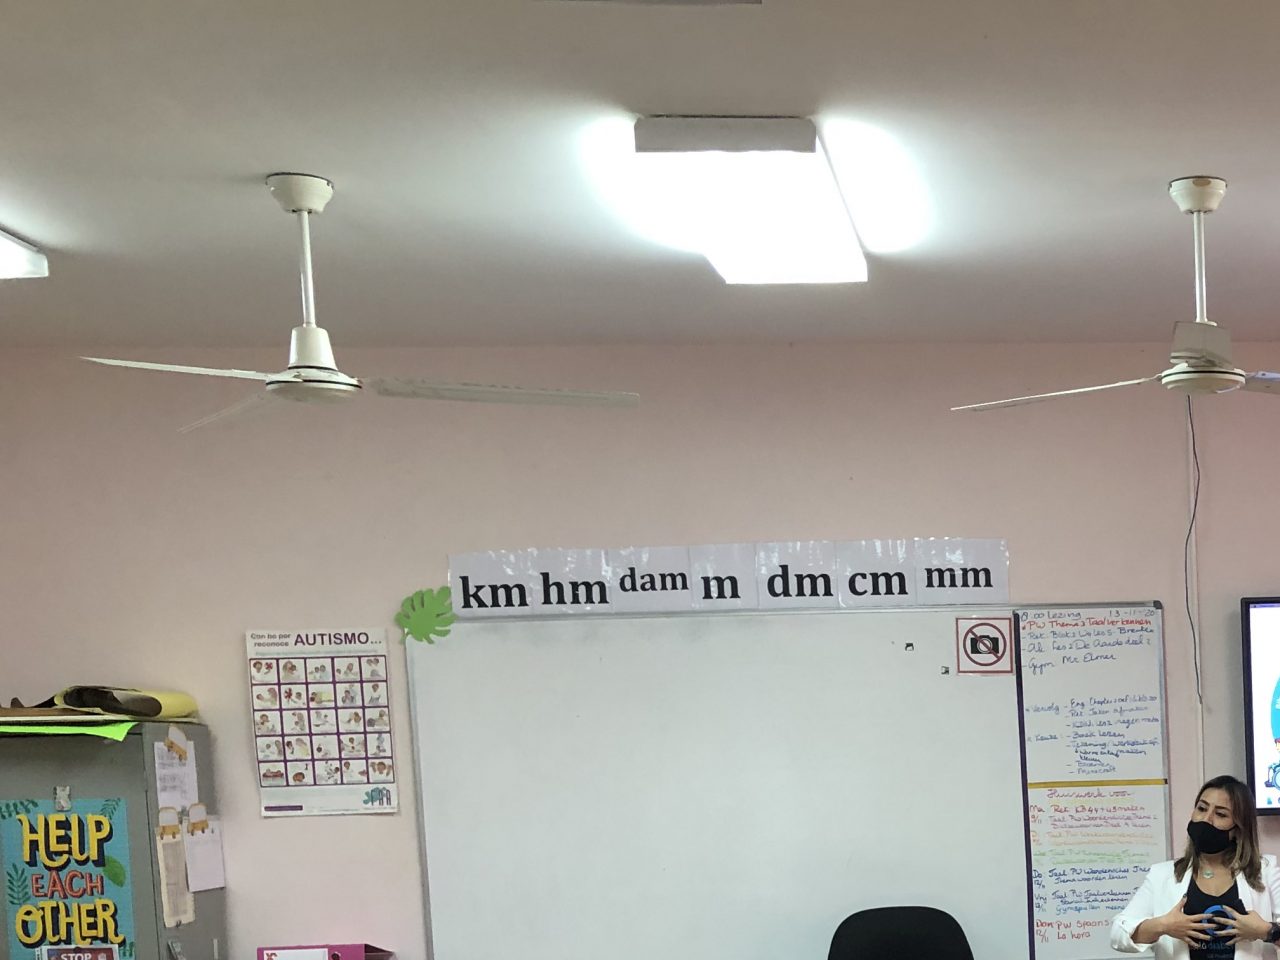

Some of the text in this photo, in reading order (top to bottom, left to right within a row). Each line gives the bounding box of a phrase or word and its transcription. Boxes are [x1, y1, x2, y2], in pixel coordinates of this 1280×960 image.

[459, 564, 993, 609] km hm dam m dm cm mm
[16, 813, 112, 867] HELP
[32, 870, 104, 899] EACH
[16, 898, 125, 946] OTHER
